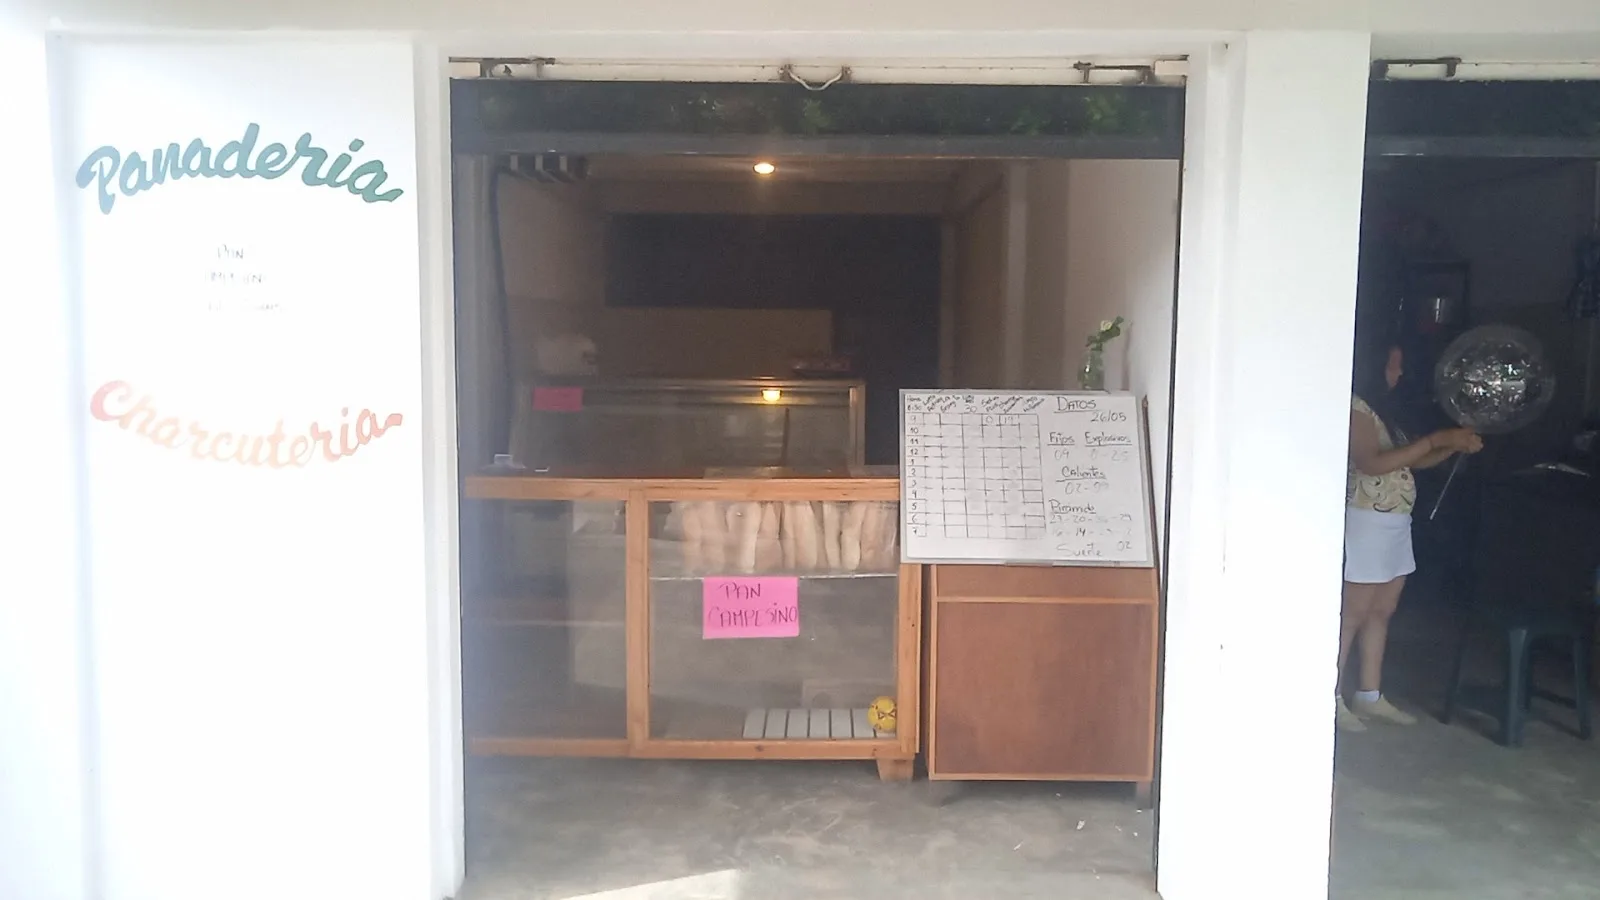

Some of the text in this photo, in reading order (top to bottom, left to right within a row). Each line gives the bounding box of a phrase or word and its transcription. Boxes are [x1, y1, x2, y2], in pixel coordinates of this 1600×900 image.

[75, 123, 404, 214] Panaderia
[1056, 396, 1097, 411] DATOS
[1090, 410, 1127, 423] 26/05
[90, 380, 403, 469] Charcuteria
[910, 448, 919, 456] 12
[911, 468, 917, 477] 2
[911, 489, 918, 499] 4
[911, 502, 918, 511] 5
[717, 582, 761, 600] PAN
